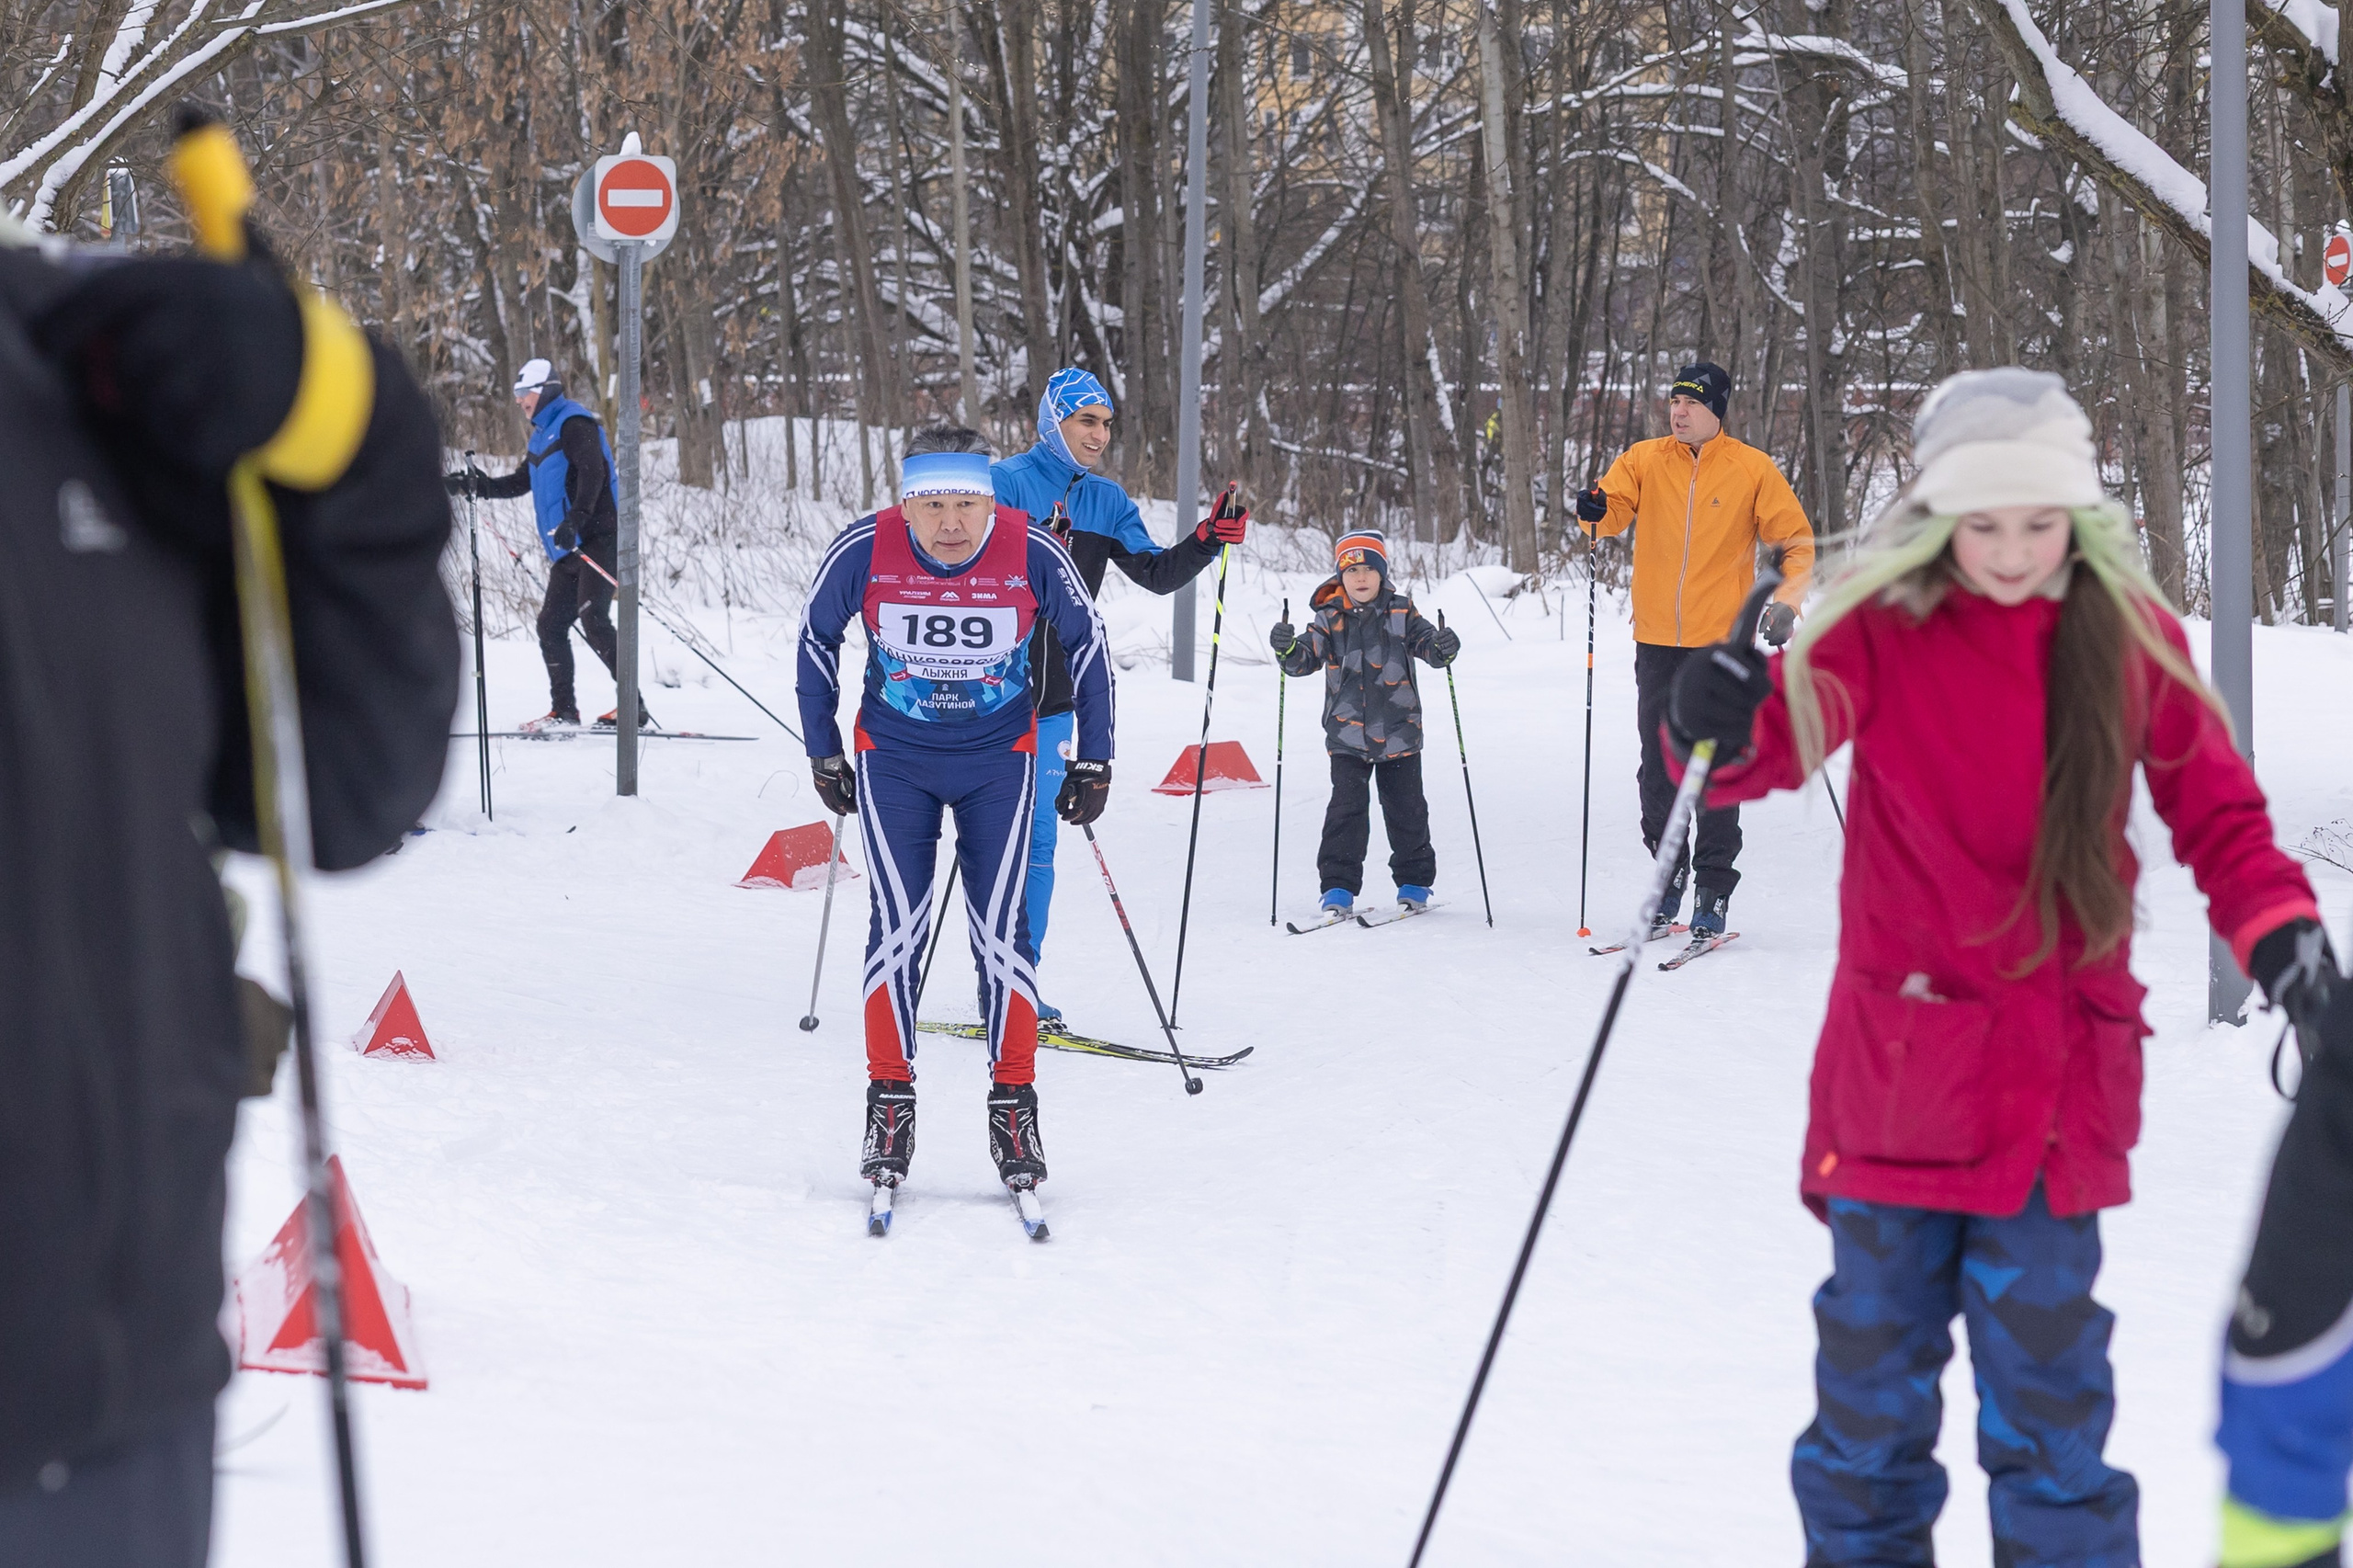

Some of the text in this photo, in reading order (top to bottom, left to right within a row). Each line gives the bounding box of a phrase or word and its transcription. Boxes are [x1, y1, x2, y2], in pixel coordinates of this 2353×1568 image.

[1057, 567, 1083, 607] STAR
[972, 592, 997, 600] ЗИМА
[902, 614, 994, 649] 189
[922, 667, 968, 678] ЛЫЖНЯ
[932, 693, 960, 701] ПАРК
[915, 699, 976, 710] ЛАЗУТИНОЙ
